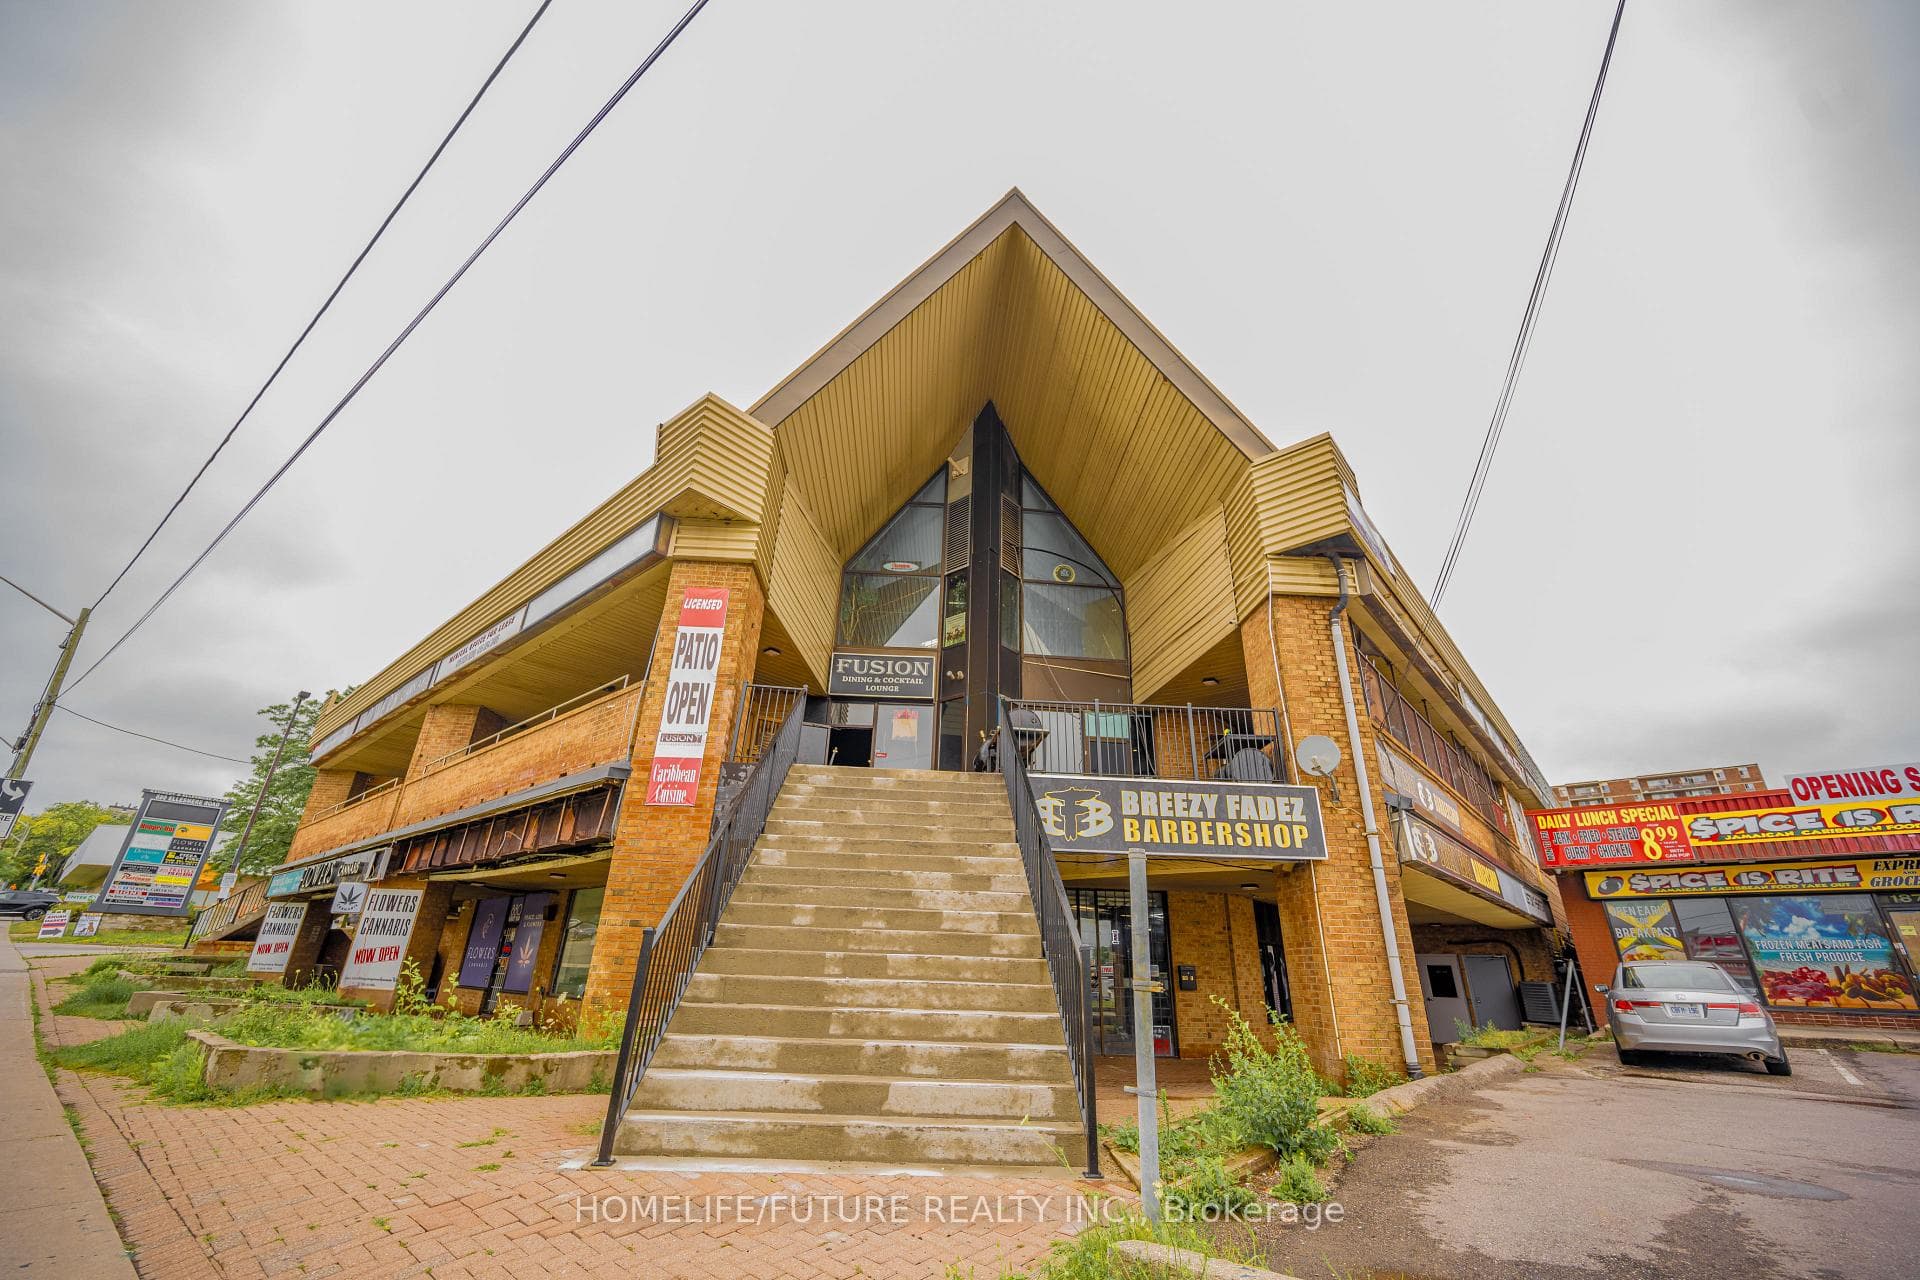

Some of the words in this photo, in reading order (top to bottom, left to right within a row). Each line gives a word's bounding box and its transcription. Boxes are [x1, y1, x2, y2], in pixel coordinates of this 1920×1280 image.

[684, 597, 723, 610] LICENSED
[674, 632, 719, 671] PATIO
[836, 658, 930, 677] FUSION
[842, 675, 873, 683] DINING
[667, 681, 710, 725] OPEN
[661, 734, 694, 742] FUSION
[653, 763, 696, 784] Caribbean
[655, 783, 687, 804] Cuisine
[1791, 768, 1903, 801] OPENING
[1121, 790, 1219, 819] BREEZY
[1226, 795, 1307, 822] FADEZ
[1537, 814, 1572, 829] DAILY
[1575, 809, 1616, 827] LUNCH
[1622, 805, 1680, 824] SPECIAL
[1840, 810, 1877, 826] IS
[1123, 818, 1309, 849] BARBERSHOP
[1553, 831, 1572, 845] JERK
[1578, 829, 1600, 843] FRIED
[1607, 826, 1640, 842] STEWED
[1724, 831, 1795, 840] JAMAICAN
[1801, 825, 1883, 836] CARIBBEAN
[1565, 845, 1591, 860] CURRY
[1597, 843, 1634, 858] CHICKEN
[1739, 871, 1766, 886] IS
[1772, 867, 1860, 885] RITE
[267, 906, 305, 919] FLOWERS
[367, 894, 418, 913] FLOWERS
[261, 922, 298, 936] CANNABIS
[360, 917, 411, 937] CANNABIS
[1614, 927, 1678, 938] BREAKFAST
[256, 944, 273, 955] NOW
[273, 942, 290, 953] OPEN
[467, 947, 496, 960] FLOWERS
[1755, 940, 1793, 950] FROZEN
[1795, 939, 1831, 950] MEATS
[1832, 939, 1855, 949] AND
[1856, 938, 1882, 949] FISH
[353, 950, 375, 965] NOW
[378, 946, 400, 961] OPEN
[1780, 951, 1812, 962] FRESH
[1815, 951, 1865, 962] PRODUCE
